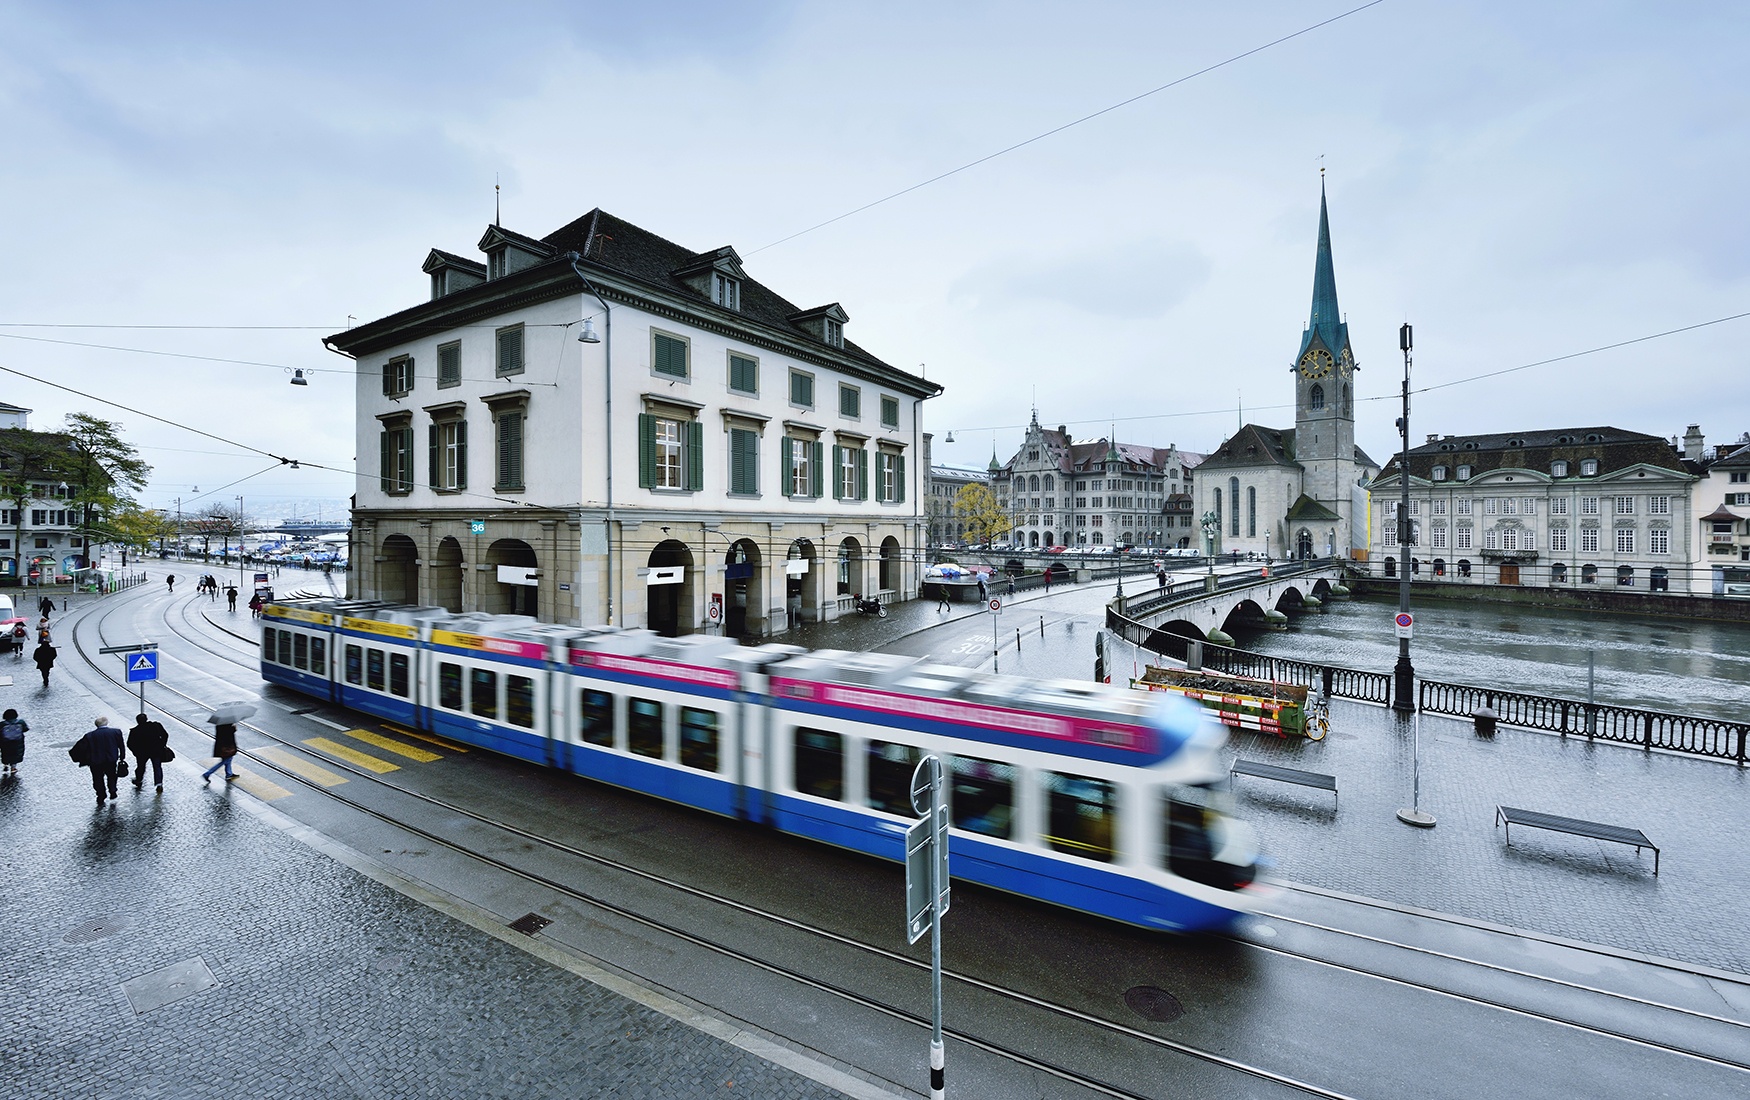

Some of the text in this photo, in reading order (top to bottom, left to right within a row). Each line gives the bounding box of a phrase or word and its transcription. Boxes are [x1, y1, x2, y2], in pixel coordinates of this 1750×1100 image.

[472, 524, 484, 532] 36
[966, 635, 995, 643] ZON
[952, 642, 985, 655] 30
